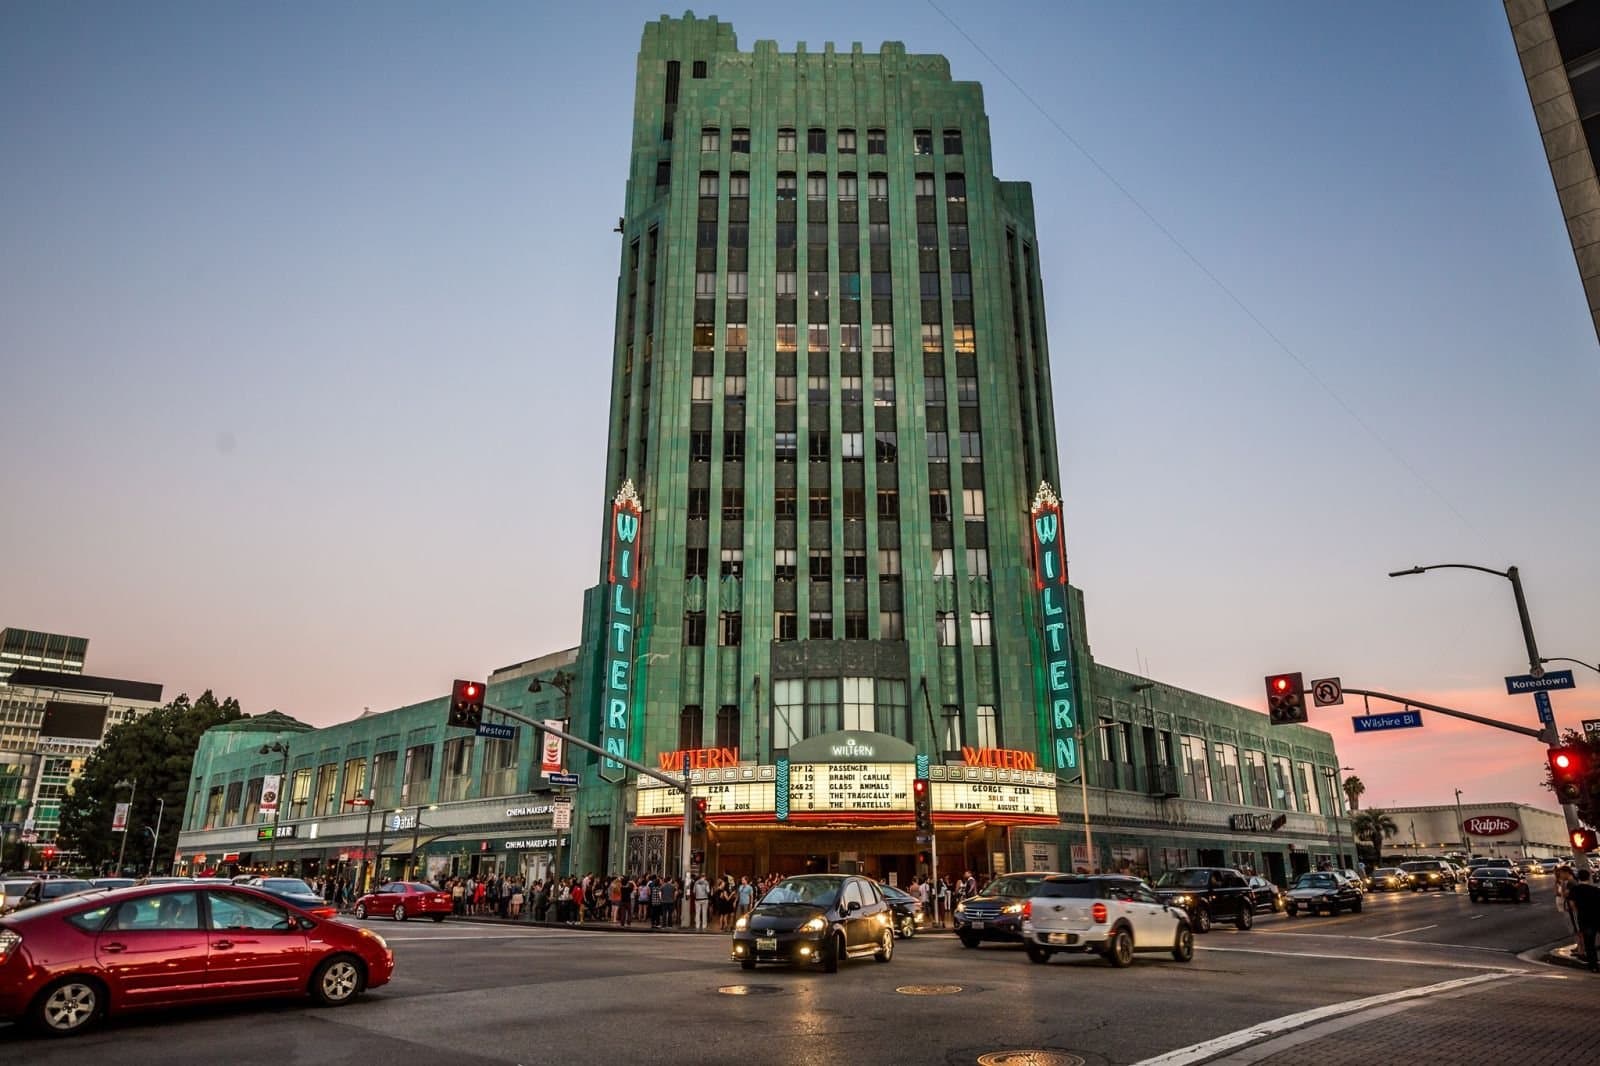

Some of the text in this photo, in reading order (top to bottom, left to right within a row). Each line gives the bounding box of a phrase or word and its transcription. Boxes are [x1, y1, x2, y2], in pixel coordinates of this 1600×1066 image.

[607, 513, 638, 769] WILTERN
[1035, 513, 1076, 769] WILTERN
[1512, 677, 1568, 689] Koreatown
[1360, 714, 1414, 728] Wilshire Bl
[479, 724, 512, 737] Western
[831, 745, 873, 756] WILTERN
[962, 746, 1036, 771] WILTERN
[805, 774, 814, 782] 19
[708, 786, 730, 794] EZRA
[972, 785, 1002, 793] GEORGE
[506, 806, 526, 817] CINEMA
[526, 804, 548, 815] MAKEUP
[652, 806, 672, 814] FRIDAY
[1470, 818, 1511, 833] Ralphs
[505, 838, 567, 849] CINEMA MAKEUP STE
